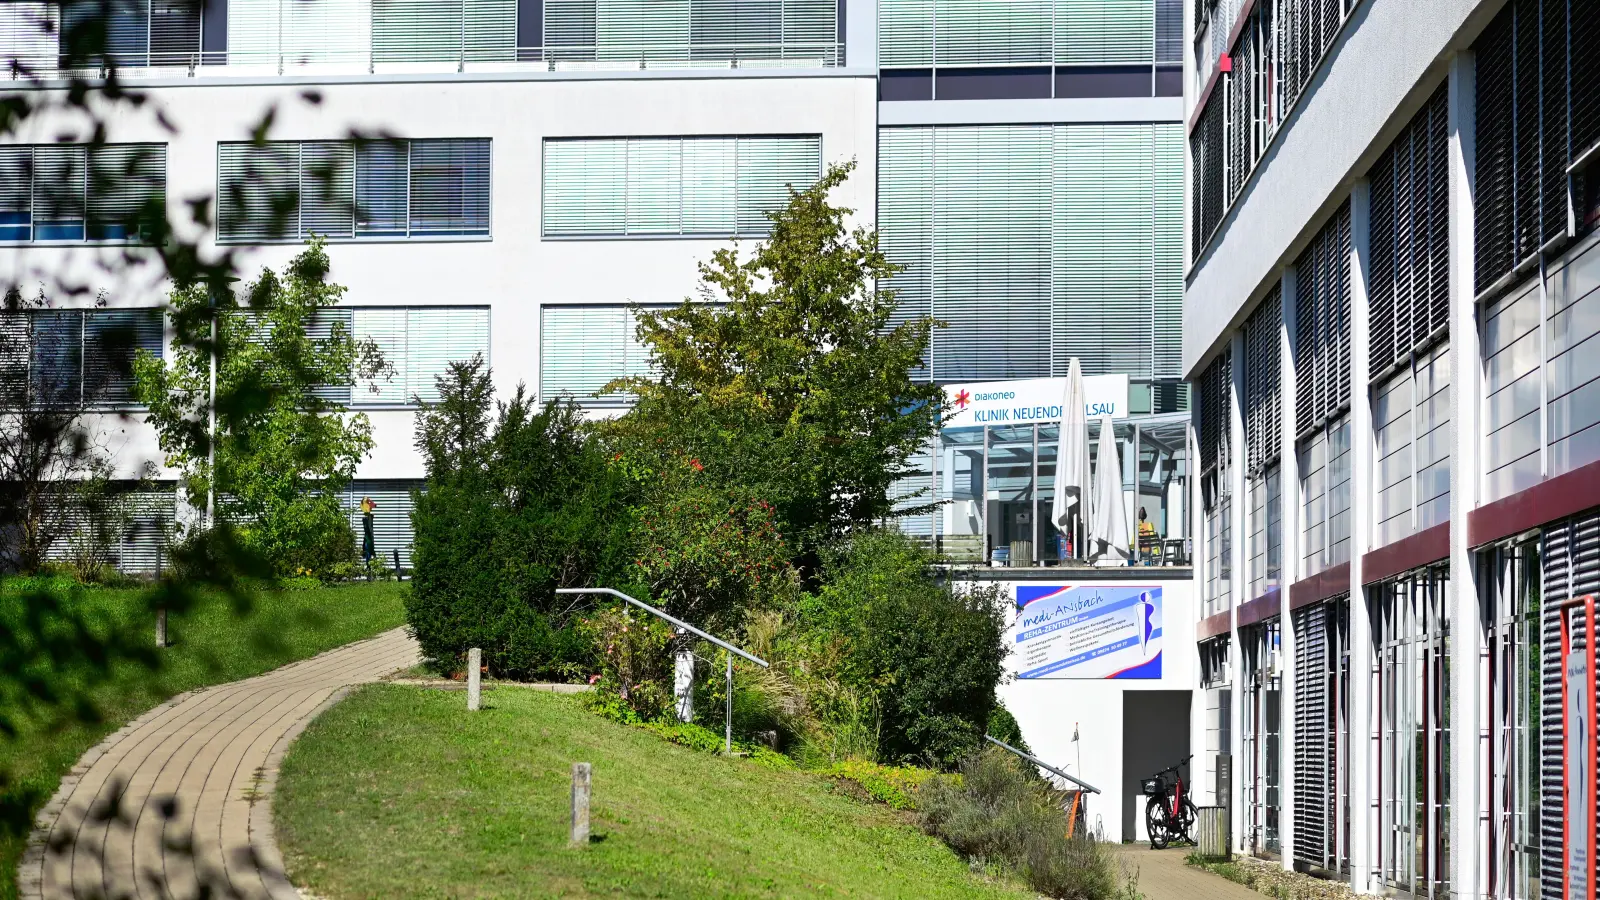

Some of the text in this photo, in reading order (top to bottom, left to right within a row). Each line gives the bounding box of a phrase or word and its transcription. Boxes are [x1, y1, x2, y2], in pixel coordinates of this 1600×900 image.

[974, 402, 1115, 422] KLINIK NEUENDLSAU
[1023, 616, 1080, 640] REHA-ZENTRUM
